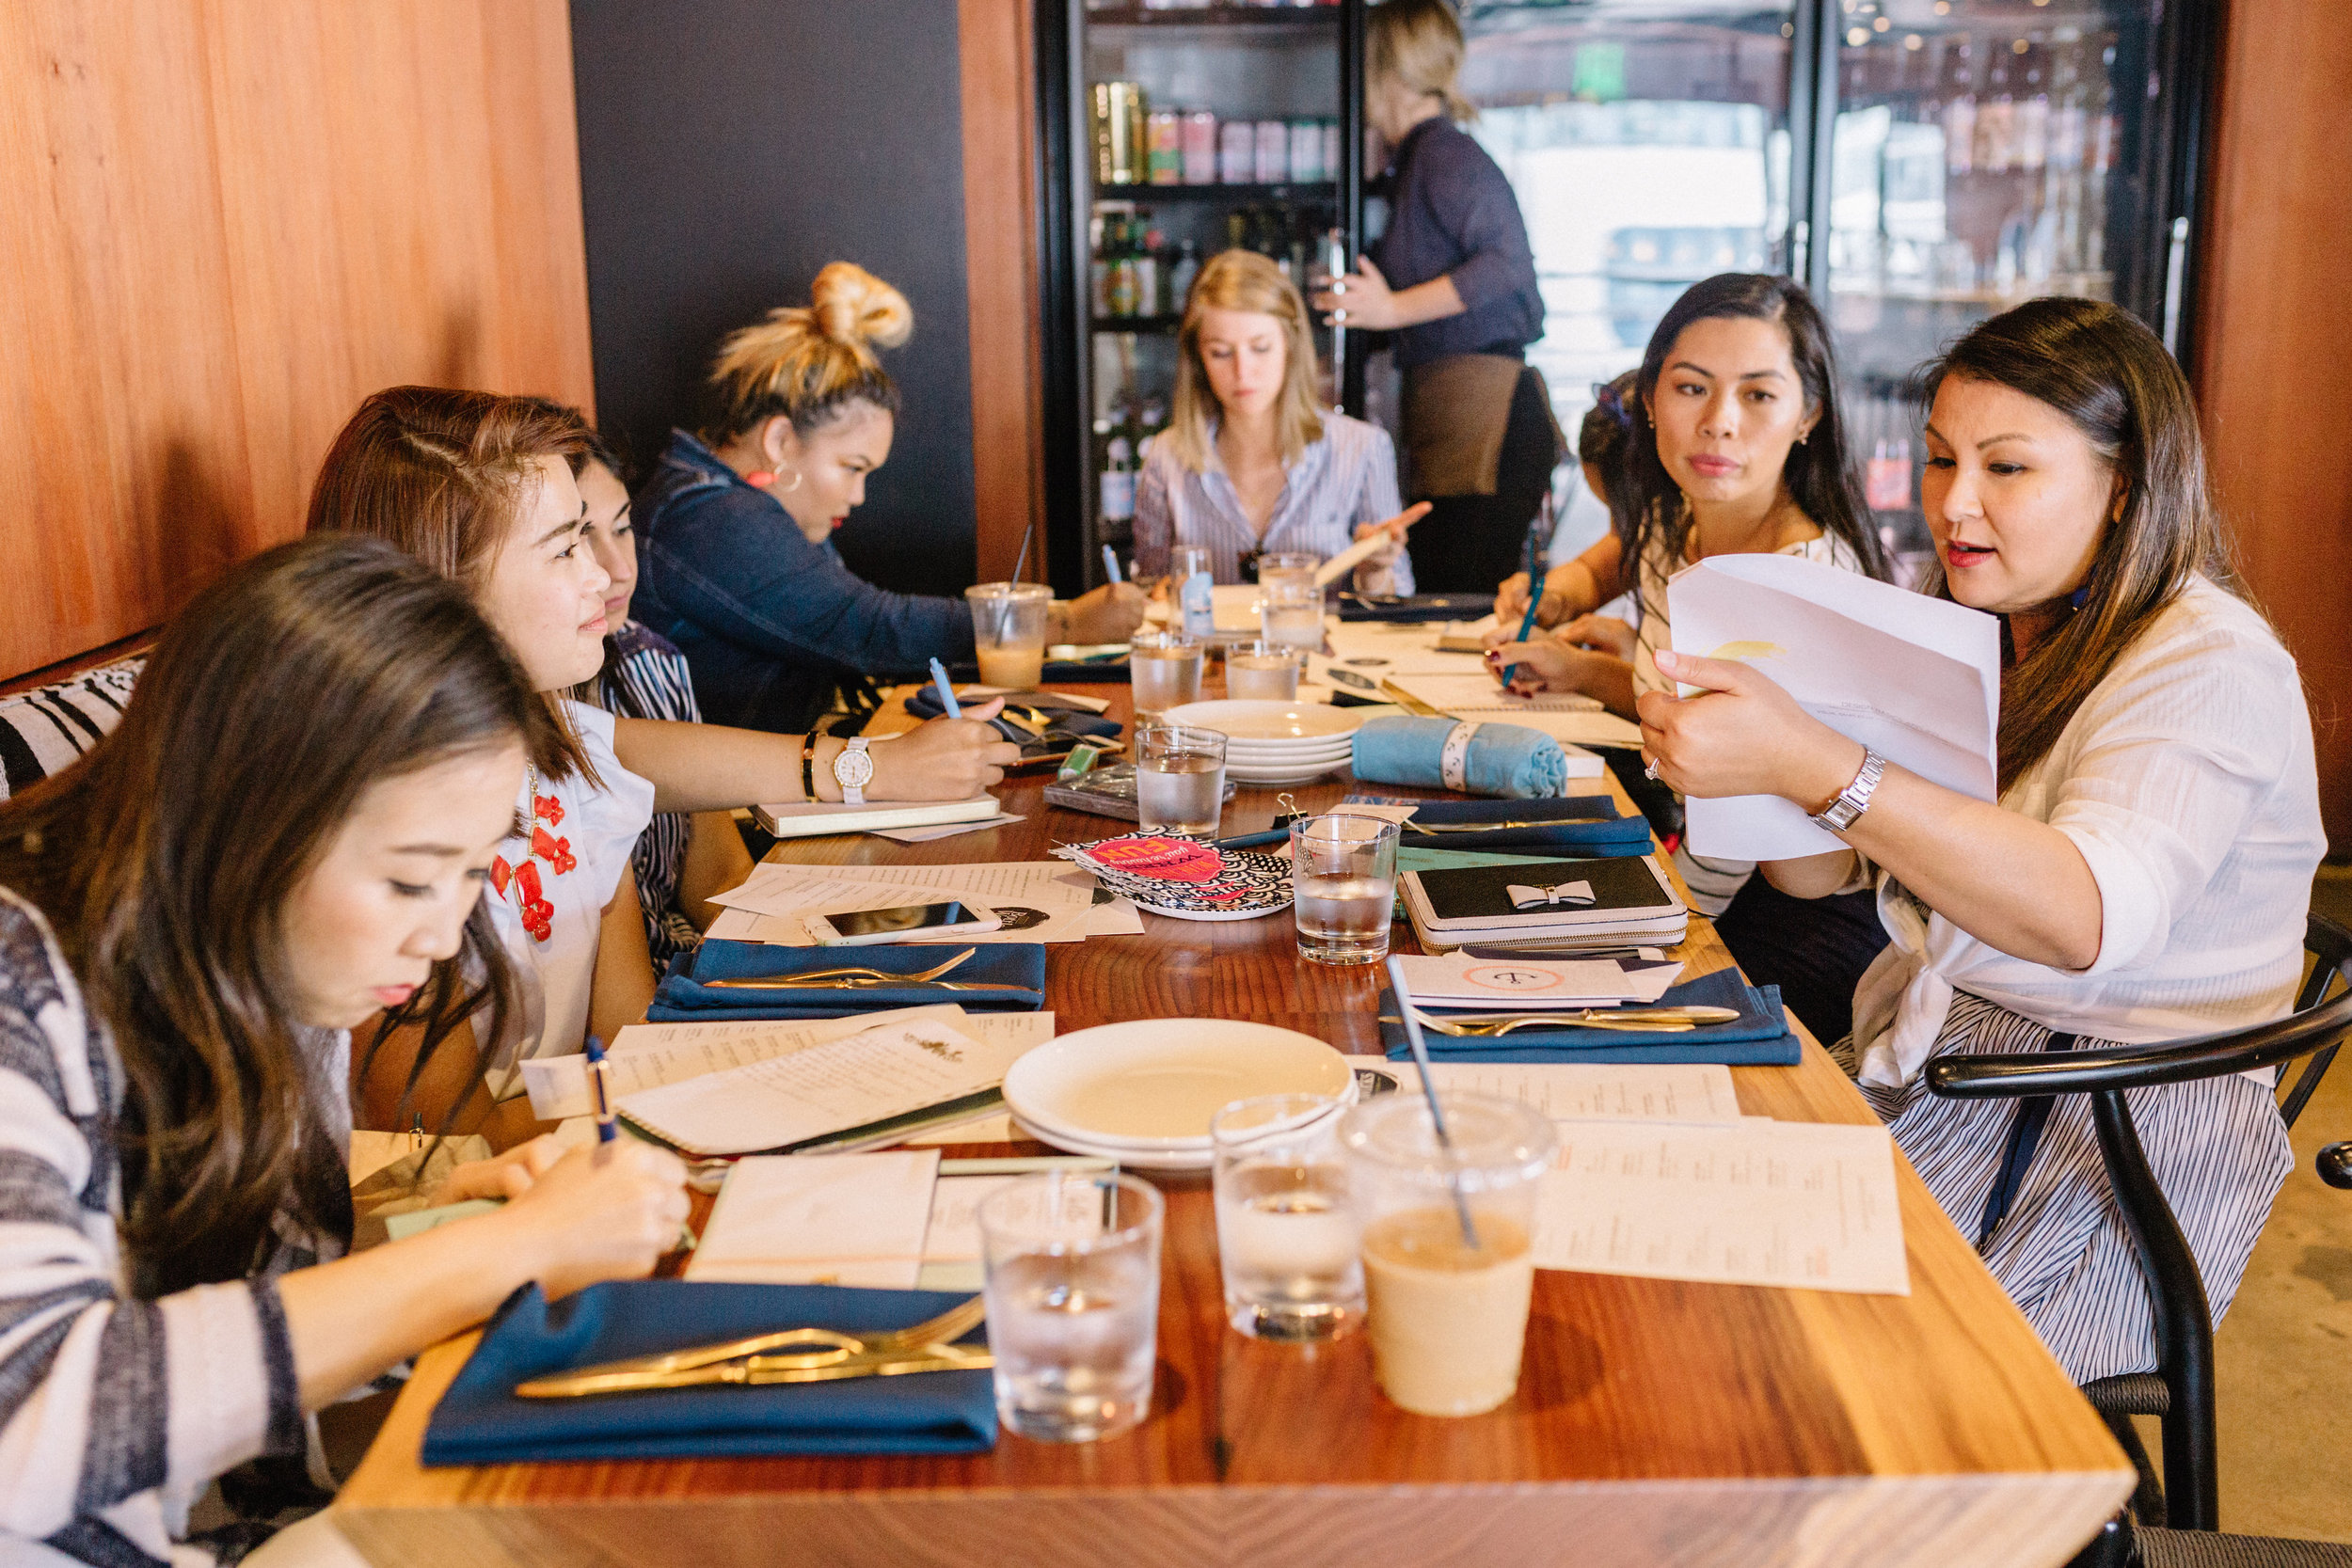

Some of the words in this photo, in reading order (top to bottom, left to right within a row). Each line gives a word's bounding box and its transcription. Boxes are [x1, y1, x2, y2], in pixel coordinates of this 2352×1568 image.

[1095, 840, 1170, 861] FUN
[1151, 846, 1189, 863] you're
[1109, 856, 1152, 865] having
